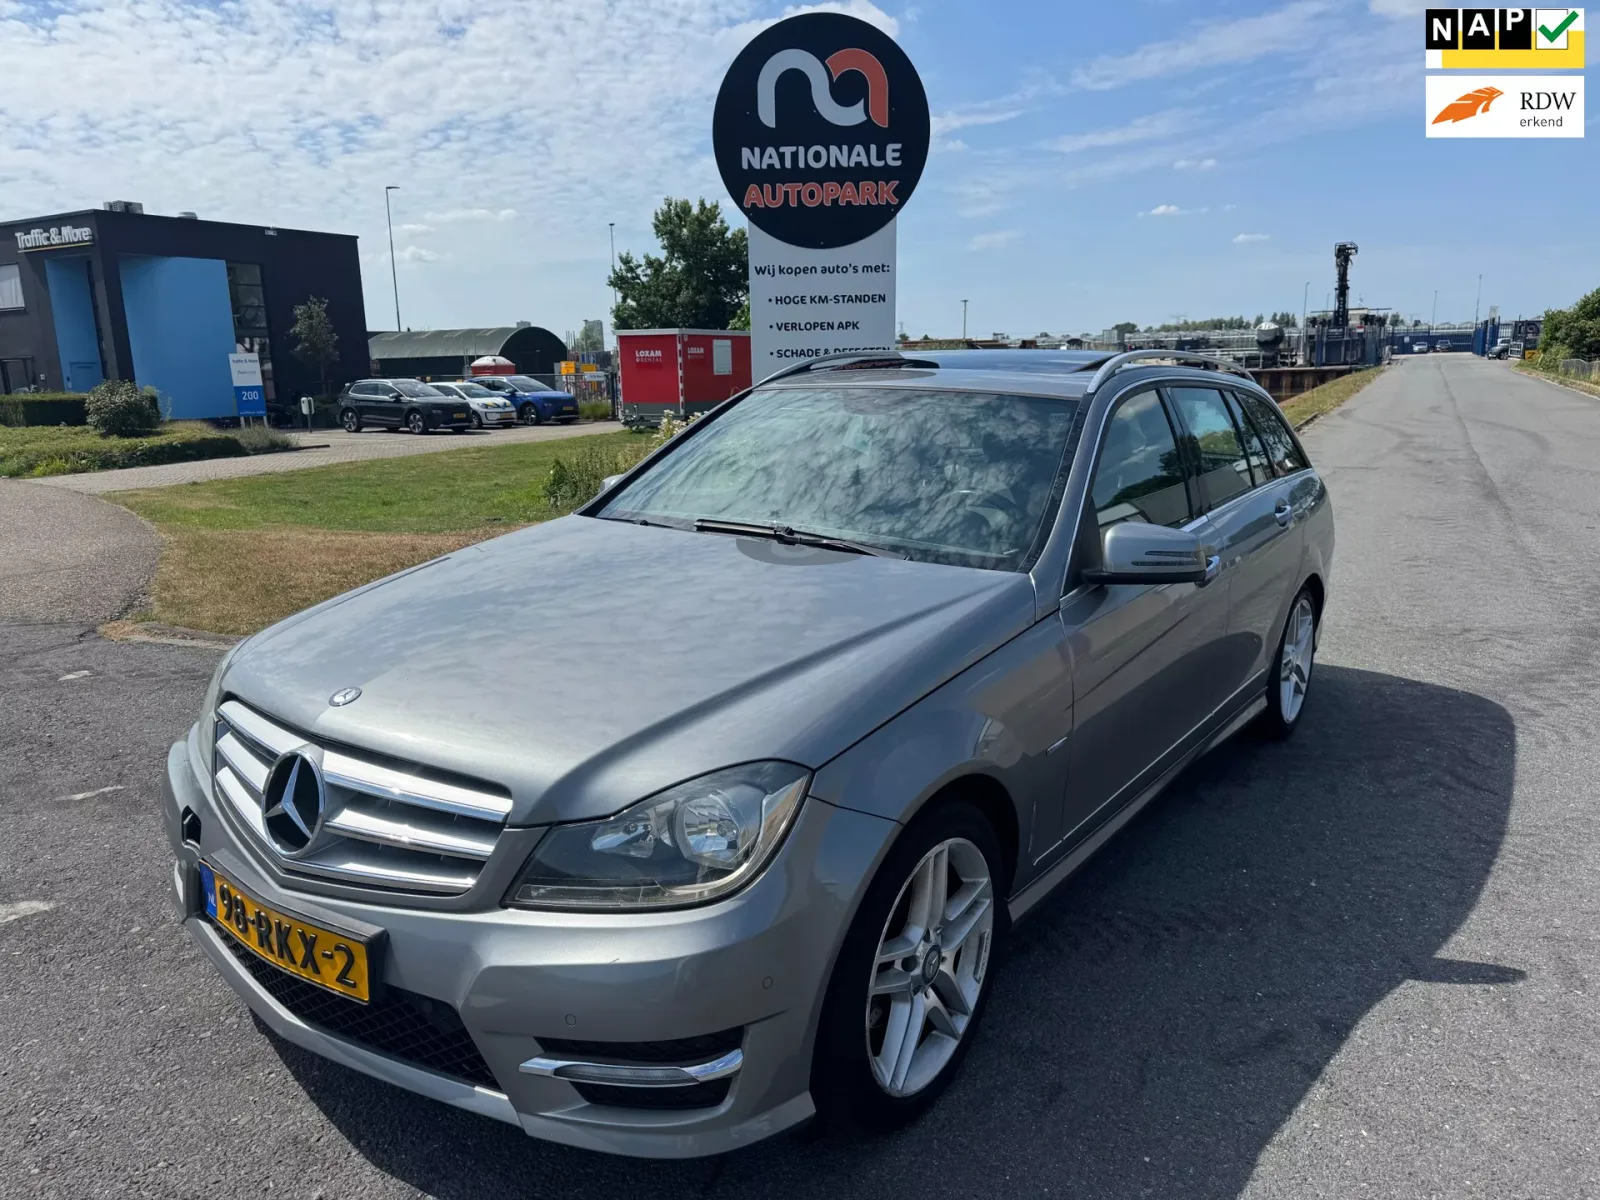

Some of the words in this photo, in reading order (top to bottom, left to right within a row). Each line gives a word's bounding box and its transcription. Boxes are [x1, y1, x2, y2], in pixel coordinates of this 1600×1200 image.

[741, 143, 902, 170] NATIONALE
[743, 181, 900, 208] AUTOPARK
[15, 228, 49, 248] Traffic
[49, 227, 61, 245] &
[61, 226, 92, 243] More
[754, 264, 776, 278] Wij
[778, 264, 818, 277] kopen
[820, 263, 859, 275] auto's
[861, 263, 890, 274] met:
[775, 295, 807, 305] HOGE
[809, 293, 886, 305] KM-STANDEN
[776, 321, 835, 332] VERLOPEN
[836, 320, 860, 331] APK
[776, 348, 821, 359] SCHADE
[241, 391, 259, 400] 200
[219, 884, 357, 988] 98-RKX-2
